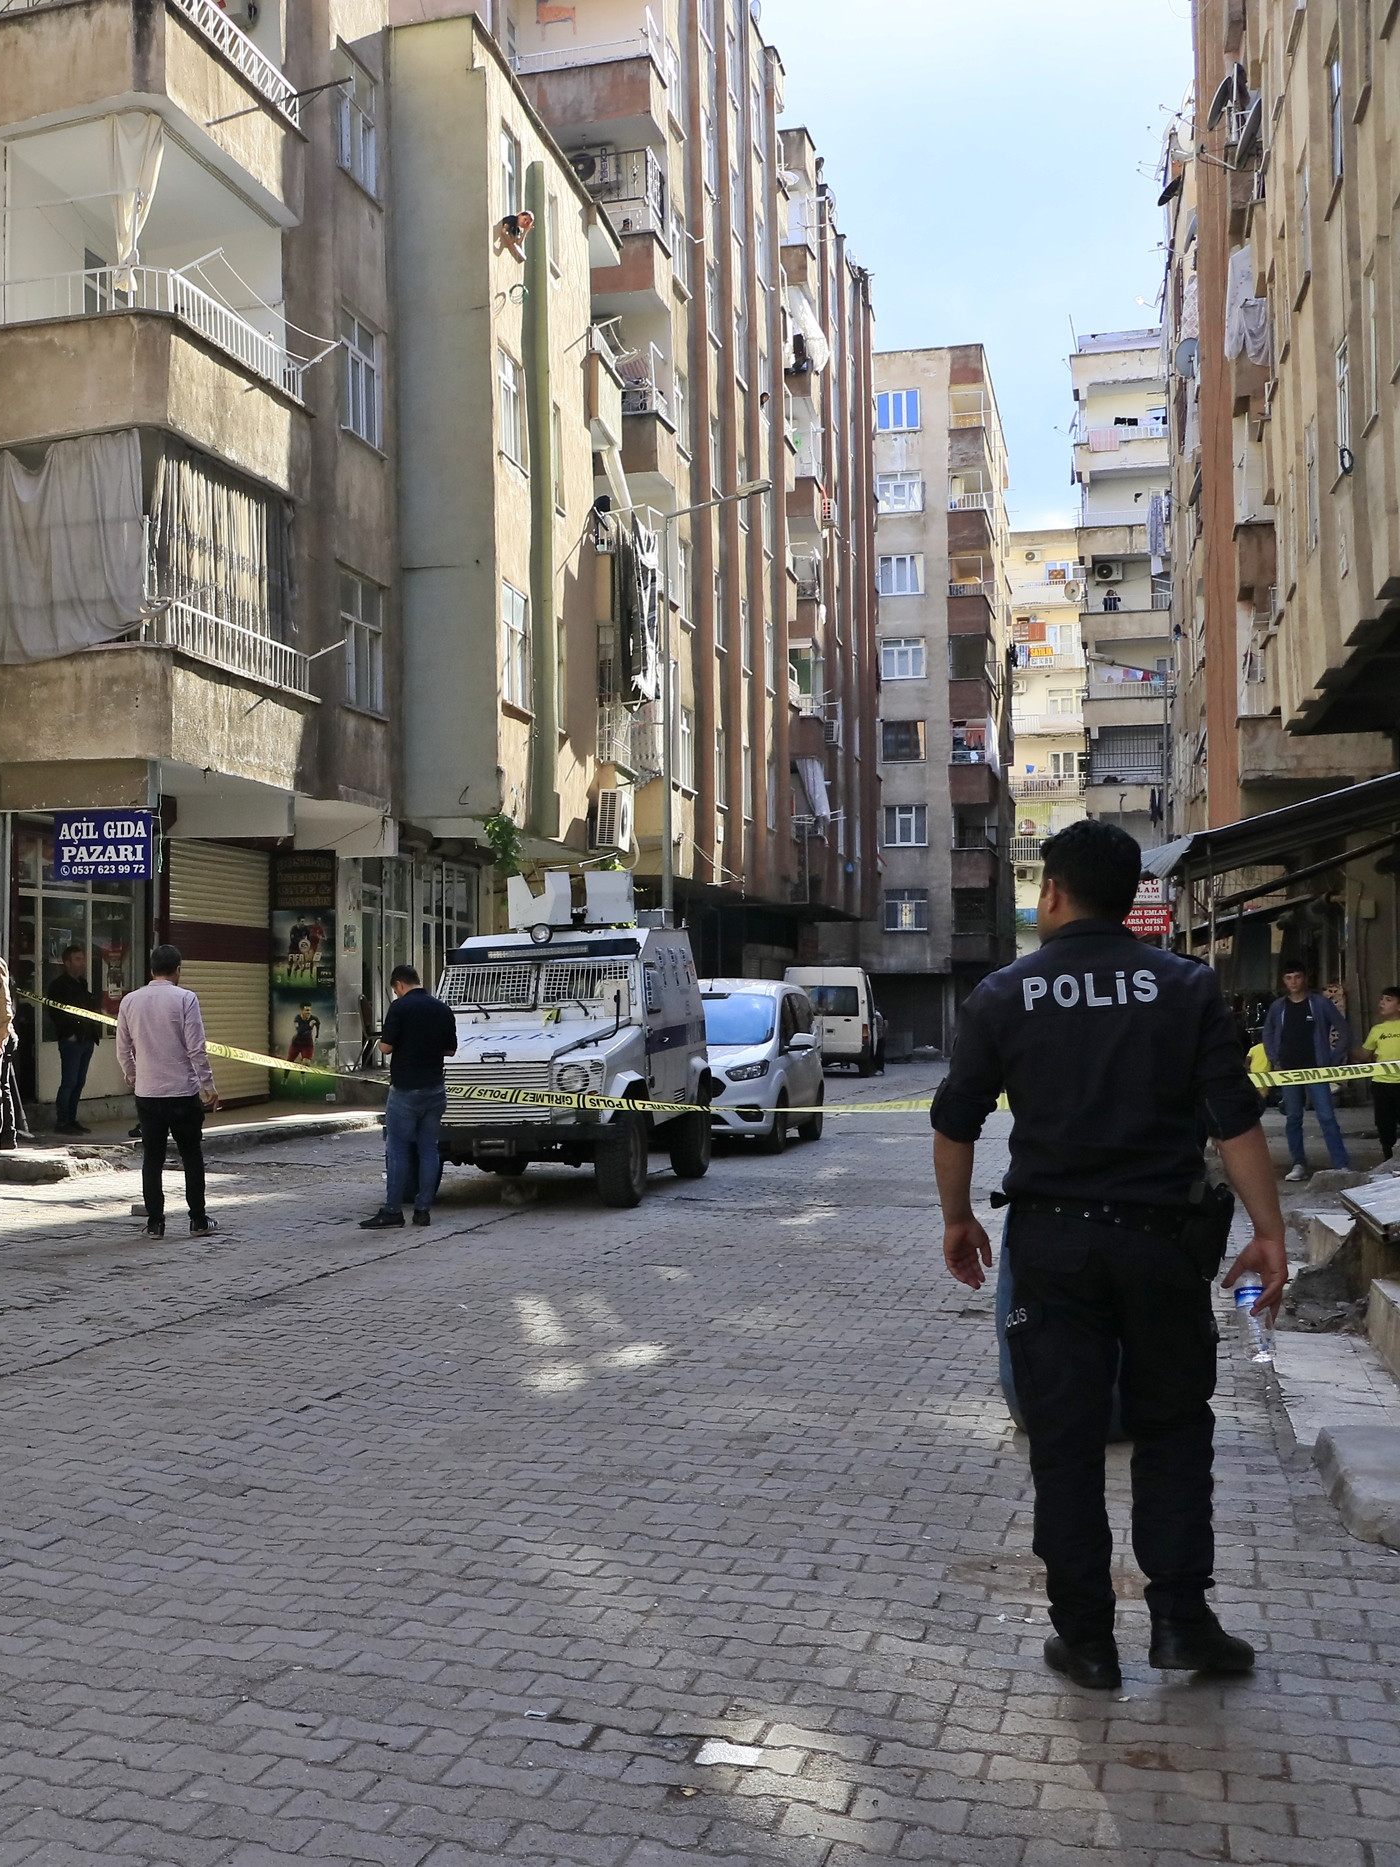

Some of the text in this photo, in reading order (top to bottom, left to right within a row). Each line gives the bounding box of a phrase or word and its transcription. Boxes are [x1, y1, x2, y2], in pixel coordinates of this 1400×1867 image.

[59, 816, 148, 845] AÇİL GIDA
[61, 844, 144, 863] PAZARI
[71, 864, 146, 875] 0537 623 99 72
